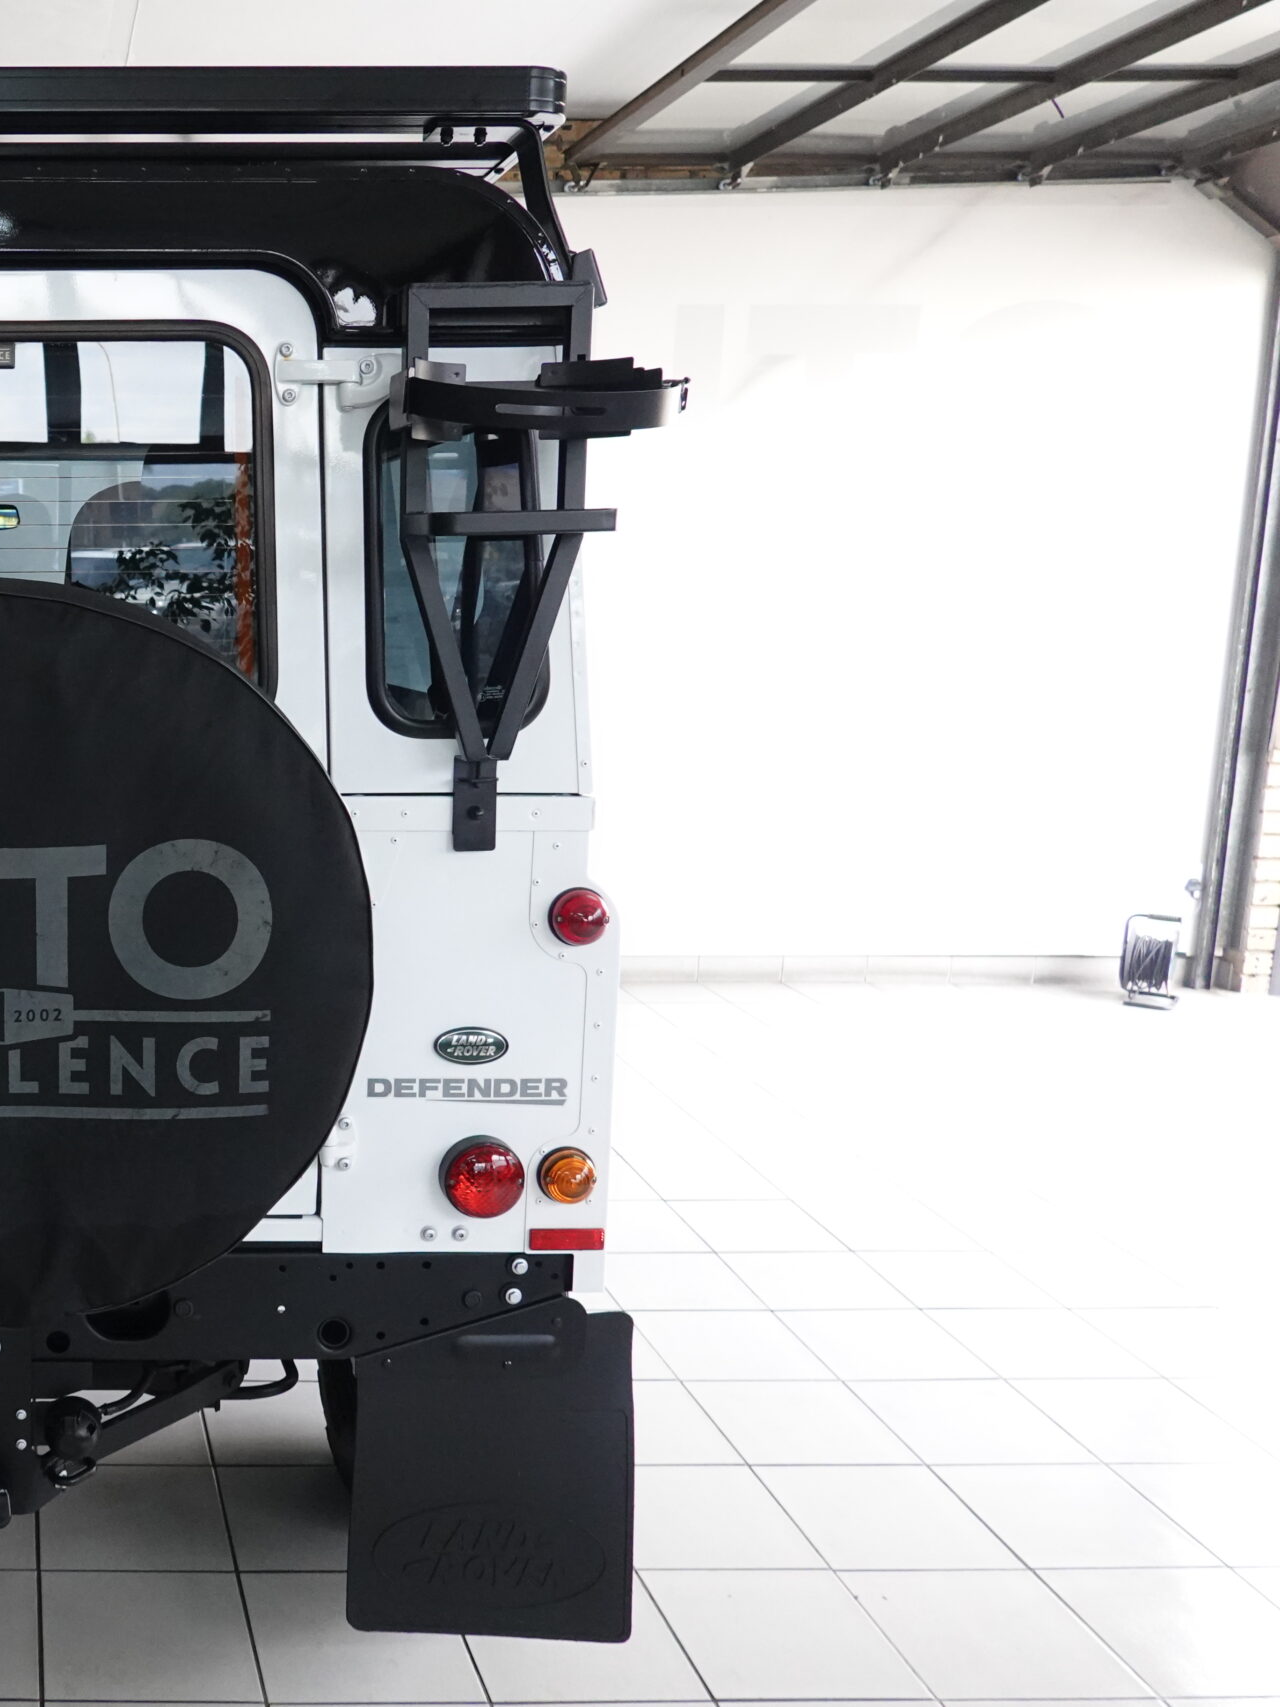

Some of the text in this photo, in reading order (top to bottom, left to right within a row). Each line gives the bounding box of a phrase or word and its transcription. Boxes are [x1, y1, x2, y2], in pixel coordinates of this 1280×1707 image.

[13, 1007, 64, 1023] 2002
[451, 1034, 486, 1046] LAND
[454, 1045, 497, 1057] ROVER
[366, 1077, 568, 1099] DEFENDER
